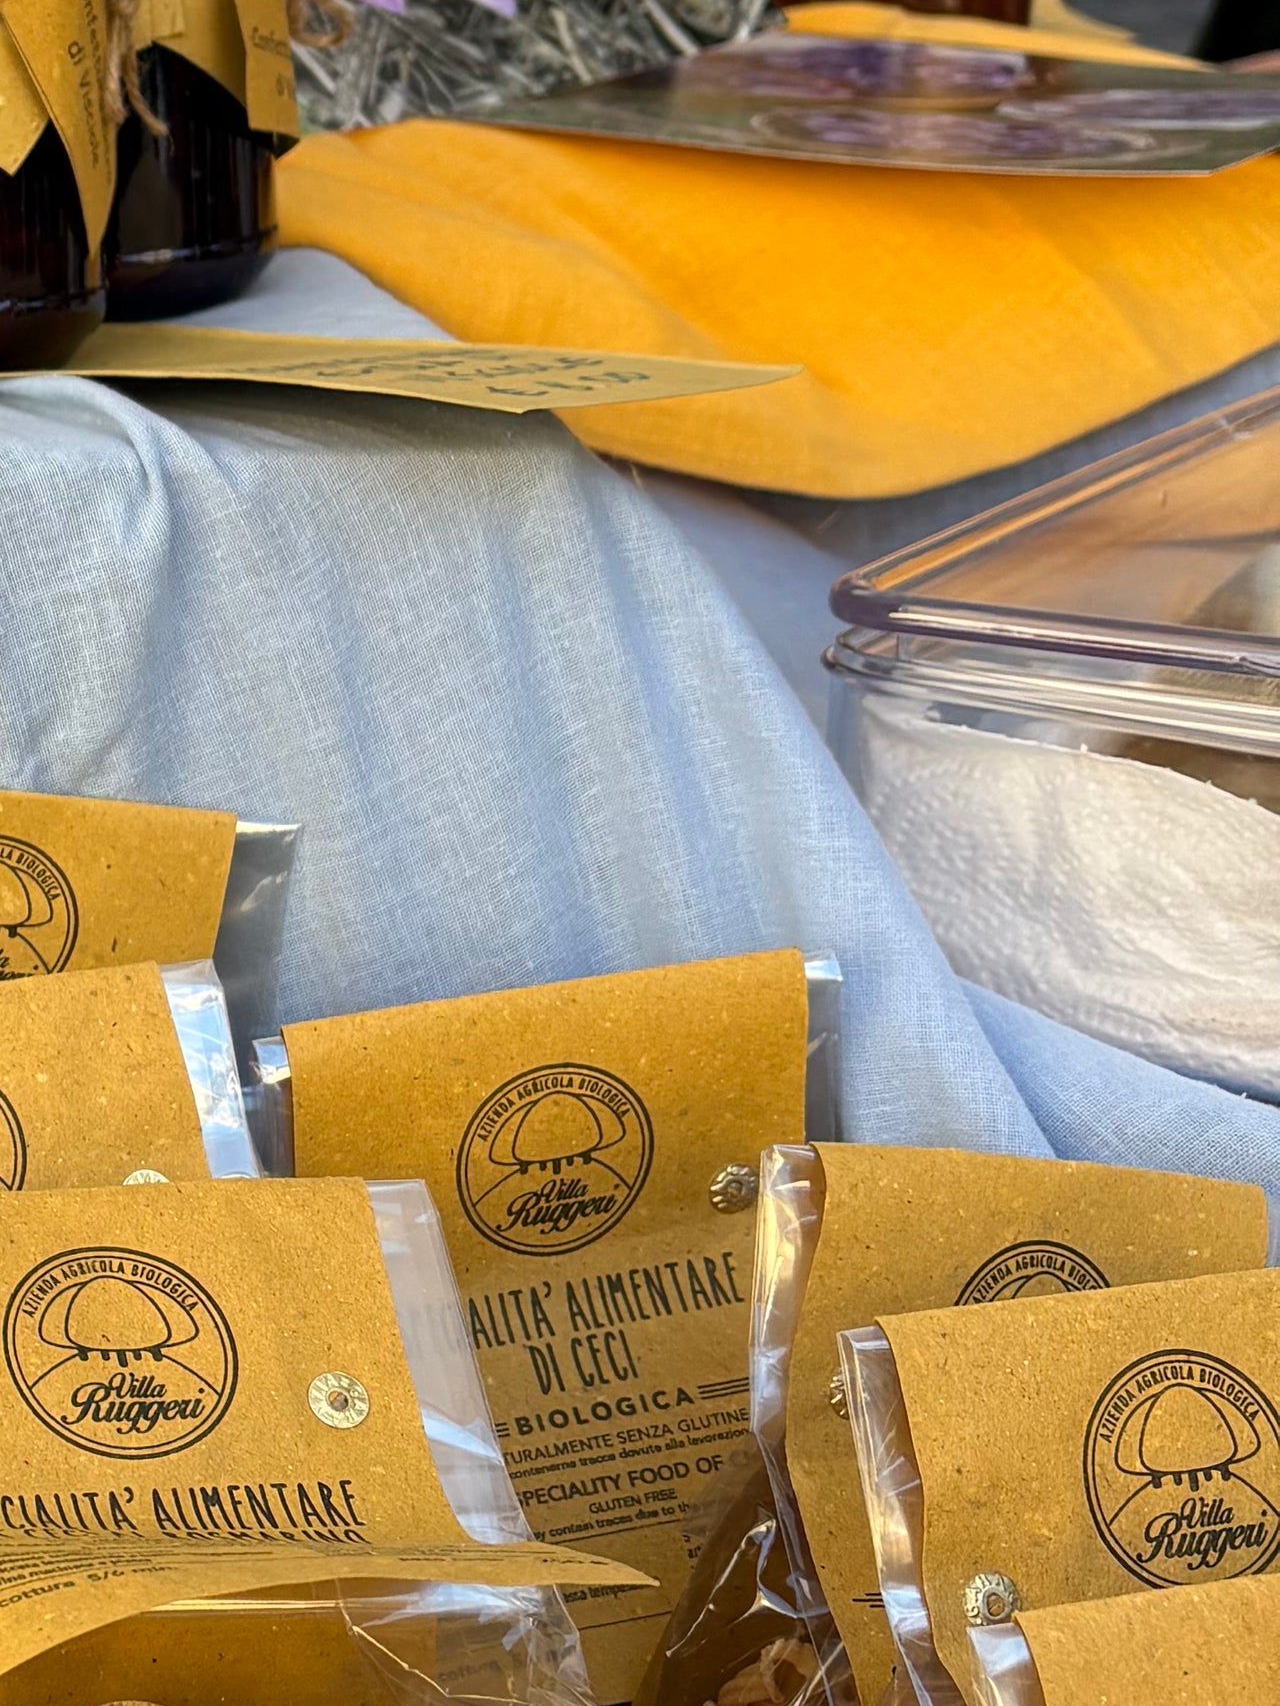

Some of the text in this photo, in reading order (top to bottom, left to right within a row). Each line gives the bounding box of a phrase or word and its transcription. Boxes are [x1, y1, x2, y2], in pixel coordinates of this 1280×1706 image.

[496, 1183, 620, 1234] Ruggeri
[540, 1178, 589, 1204] Villa
[21, 1259, 199, 1318] AZIENDA AGRICOLA BIOLOGICA
[565, 1252, 745, 1333] ALIMENTARE
[107, 1372, 168, 1399] Villa
[523, 1329, 639, 1396] DI CECI
[60, 1382, 206, 1434] Ruggeri
[513, 1387, 695, 1436] BIOLOGICA
[616, 1422, 674, 1445] SENZA
[677, 1407, 750, 1433] GLUTINE
[627, 1460, 690, 1488] FOOD
[695, 1454, 725, 1475] OF
[151, 1479, 366, 1532] ALIMENTARE
[588, 1487, 678, 1514] GLUTEN FREE
[1181, 1496, 1234, 1530] Villa
[1136, 1510, 1269, 1571] Ruggeri
